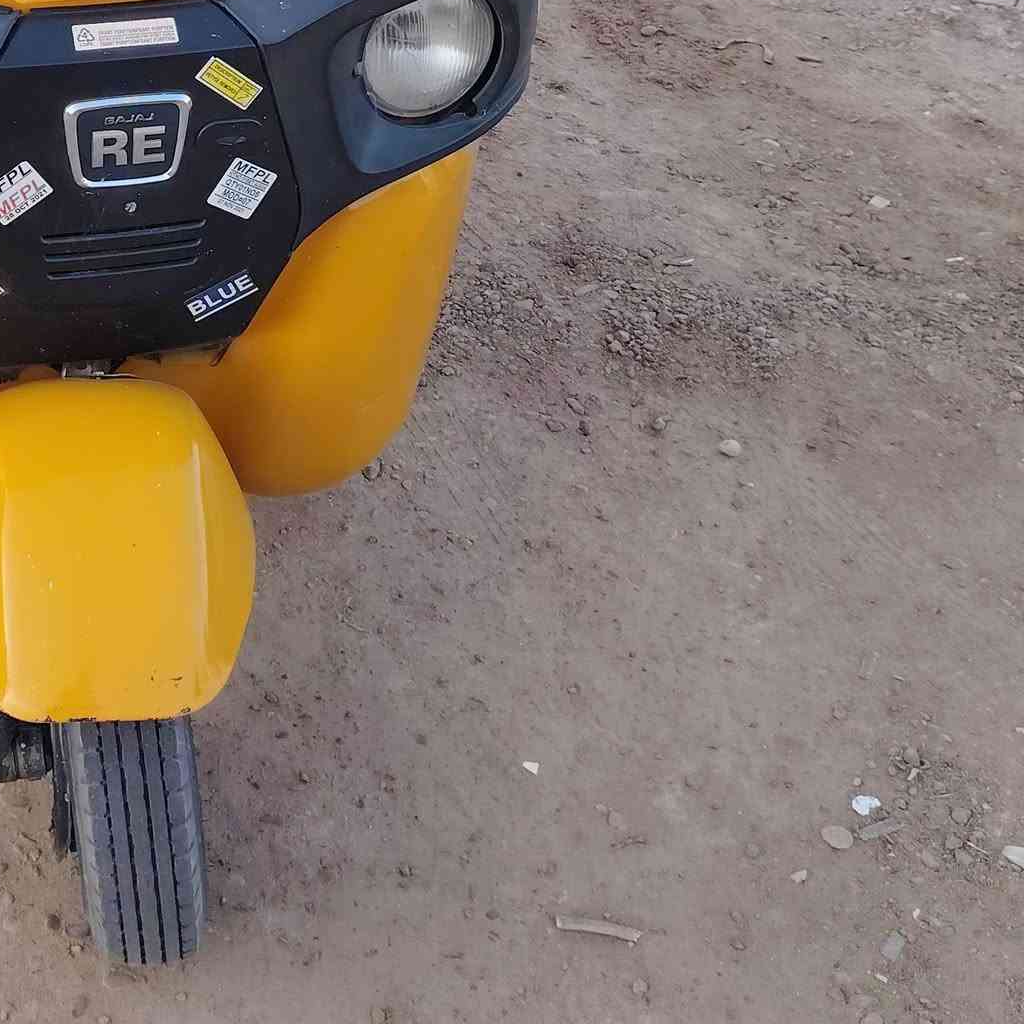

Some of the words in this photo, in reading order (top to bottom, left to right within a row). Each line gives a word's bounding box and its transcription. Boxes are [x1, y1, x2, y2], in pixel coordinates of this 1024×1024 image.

[91, 125, 166, 169] RE
[233, 160, 270, 184] MFPL
[14, 202, 29, 213] OCT
[186, 274, 255, 316] BLUE
